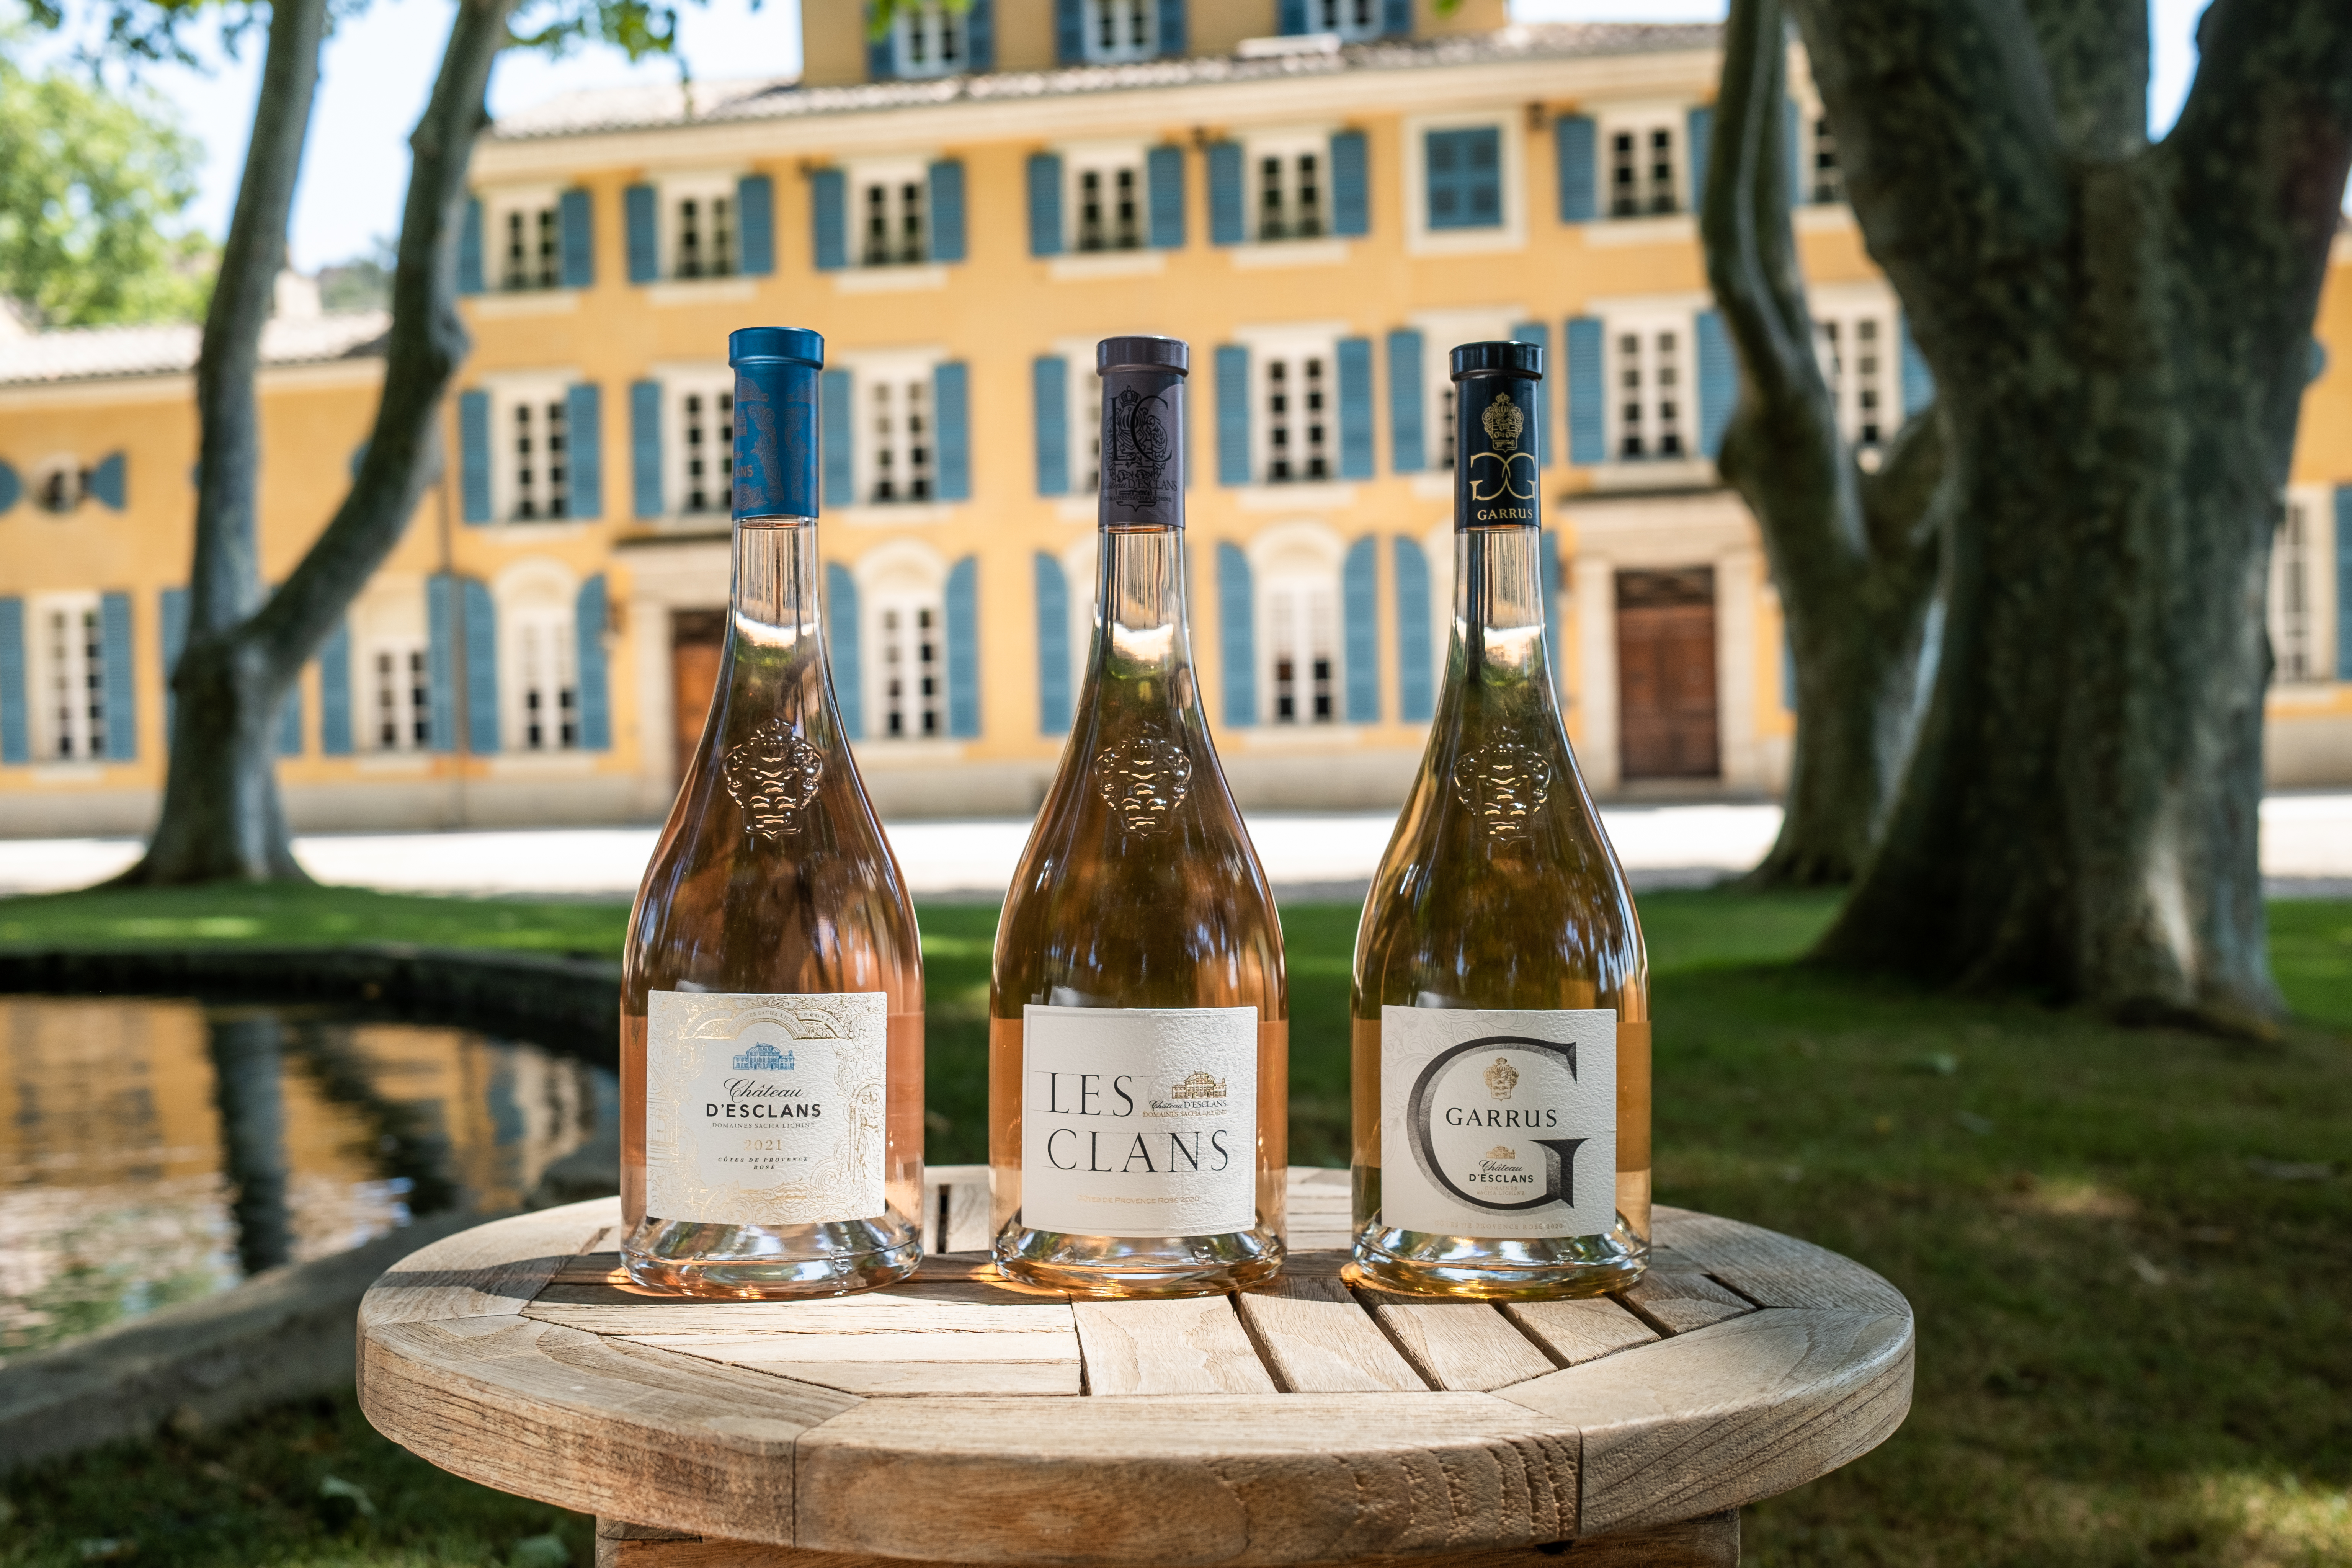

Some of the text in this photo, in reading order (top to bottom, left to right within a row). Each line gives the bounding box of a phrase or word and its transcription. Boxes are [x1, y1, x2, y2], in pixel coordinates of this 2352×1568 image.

[1127, 479, 1177, 491] D'ESCLANS
[1477, 508, 1532, 520] GARRUS
[724, 1078, 804, 1103] Château
[1049, 1073, 1134, 1117] LES
[1149, 1100, 1227, 1111] Château D'ESCLANS
[1446, 1107, 1557, 1127] GARRUS
[744, 1139, 782, 1150] 2021
[1048, 1129, 1228, 1173] CLANS
[1479, 1160, 1524, 1174] Château
[1469, 1174, 1534, 1183] D'ESCLANS
